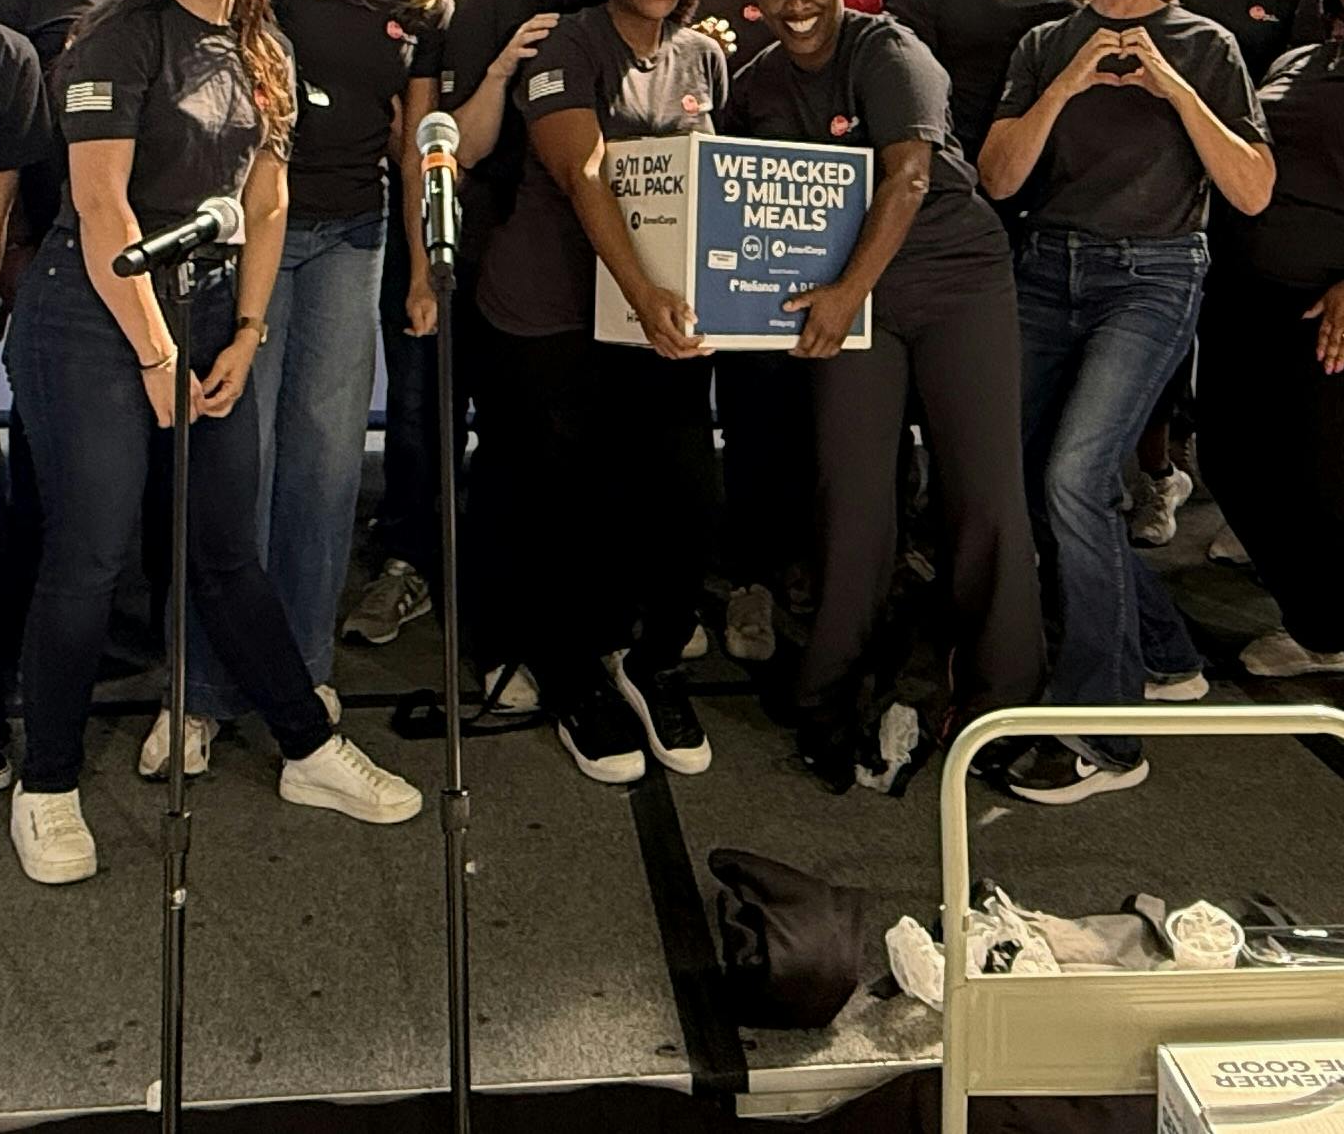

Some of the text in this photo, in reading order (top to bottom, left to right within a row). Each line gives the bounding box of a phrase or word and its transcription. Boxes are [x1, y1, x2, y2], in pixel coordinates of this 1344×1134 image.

[616, 154, 672, 178] 9/11 DAY
[713, 154, 856, 186] WE PACKED
[645, 175, 684, 195] PACK
[724, 179, 844, 209] 9 MILLION
[744, 205, 827, 231] MEALS
[1218, 1060, 1312, 1074] GOOD
